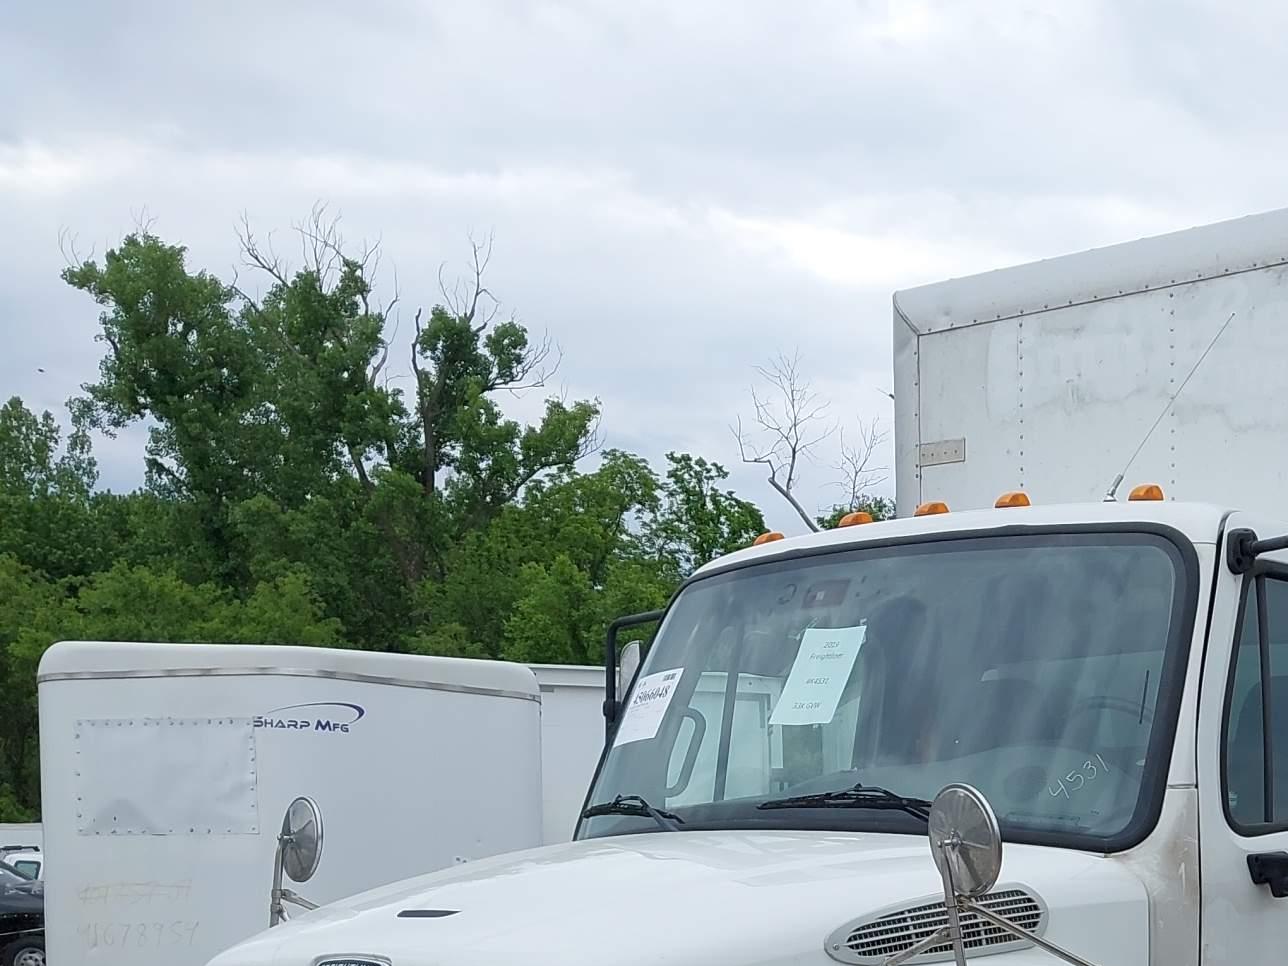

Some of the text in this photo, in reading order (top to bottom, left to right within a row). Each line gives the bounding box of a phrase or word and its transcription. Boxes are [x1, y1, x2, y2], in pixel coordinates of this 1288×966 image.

[633, 685, 671, 705] 45066048
[253, 716, 311, 729] SHARP
[1048, 753, 1109, 799] 4531
